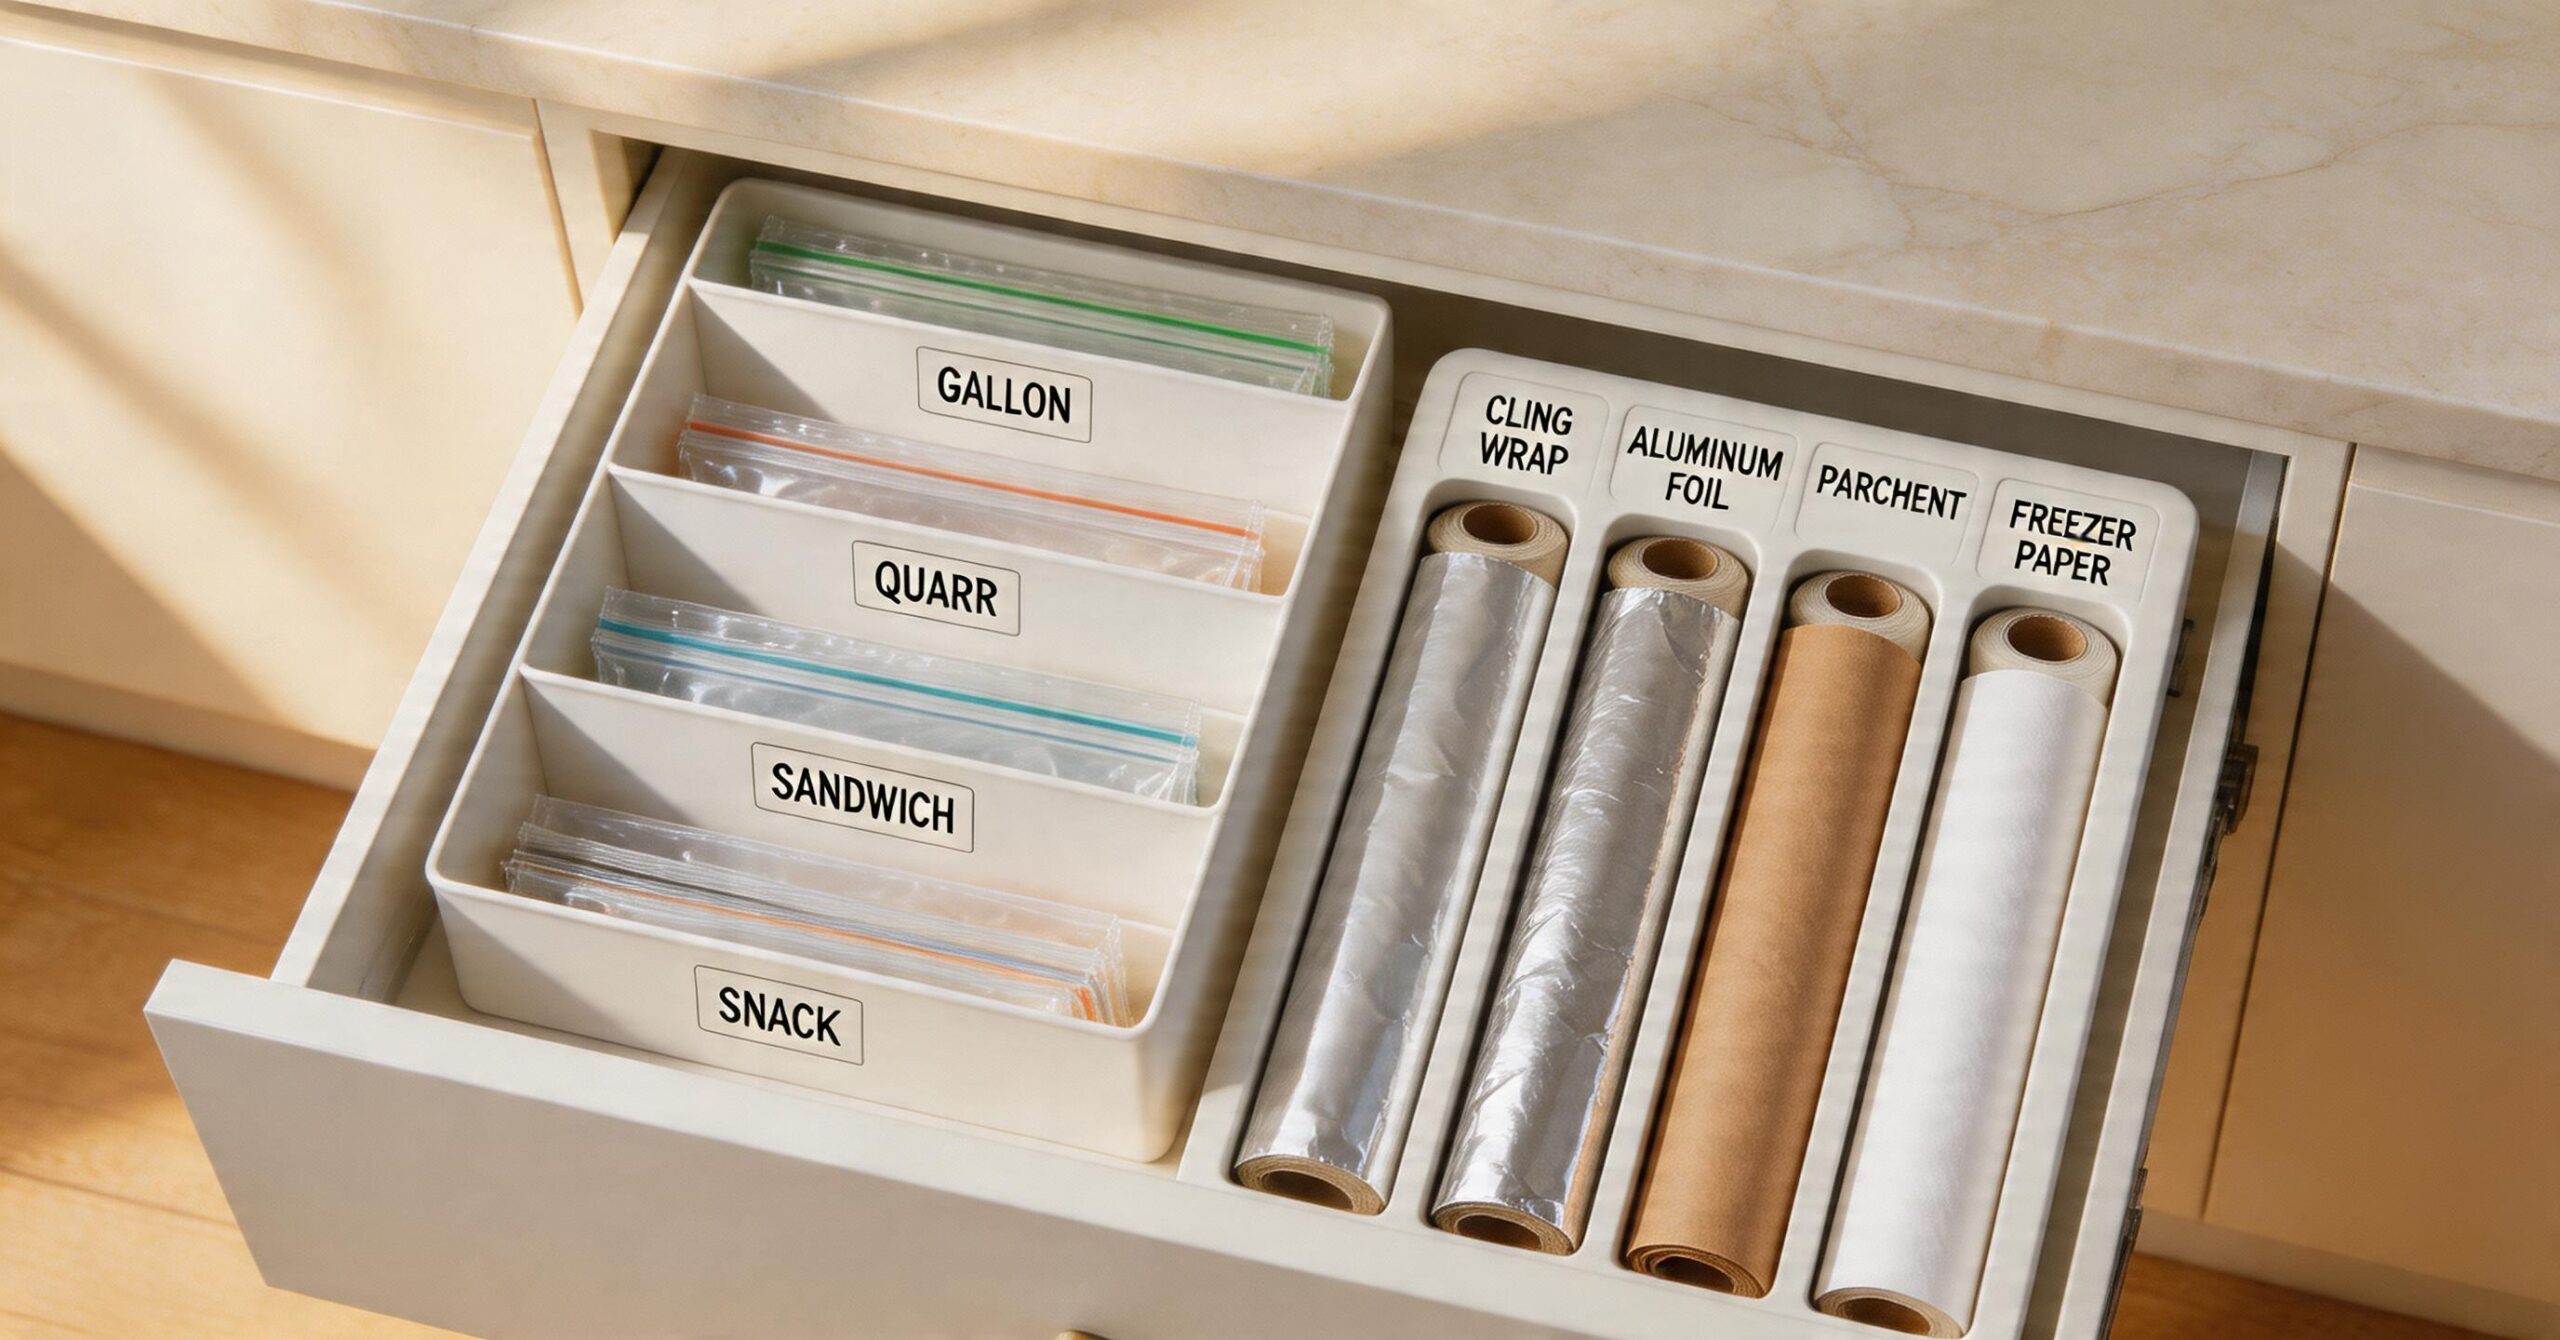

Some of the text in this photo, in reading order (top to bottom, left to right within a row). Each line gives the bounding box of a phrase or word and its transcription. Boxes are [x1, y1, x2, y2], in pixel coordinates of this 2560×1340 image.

[937, 366, 1071, 424] GALLON
[1485, 395, 1573, 436] CLING
[1480, 431, 1569, 476] WRAP
[1626, 425, 1784, 481] ALUMINUM
[1665, 471, 1729, 510] FOIL
[1815, 464, 1968, 520] PARCHENT
[2009, 499, 2137, 552] FREEZER
[875, 560, 998, 617] QUARR
[2013, 539, 2111, 586] PAPER
[771, 762, 954, 834] SANDWICH
[718, 986, 841, 1047] SNACK
